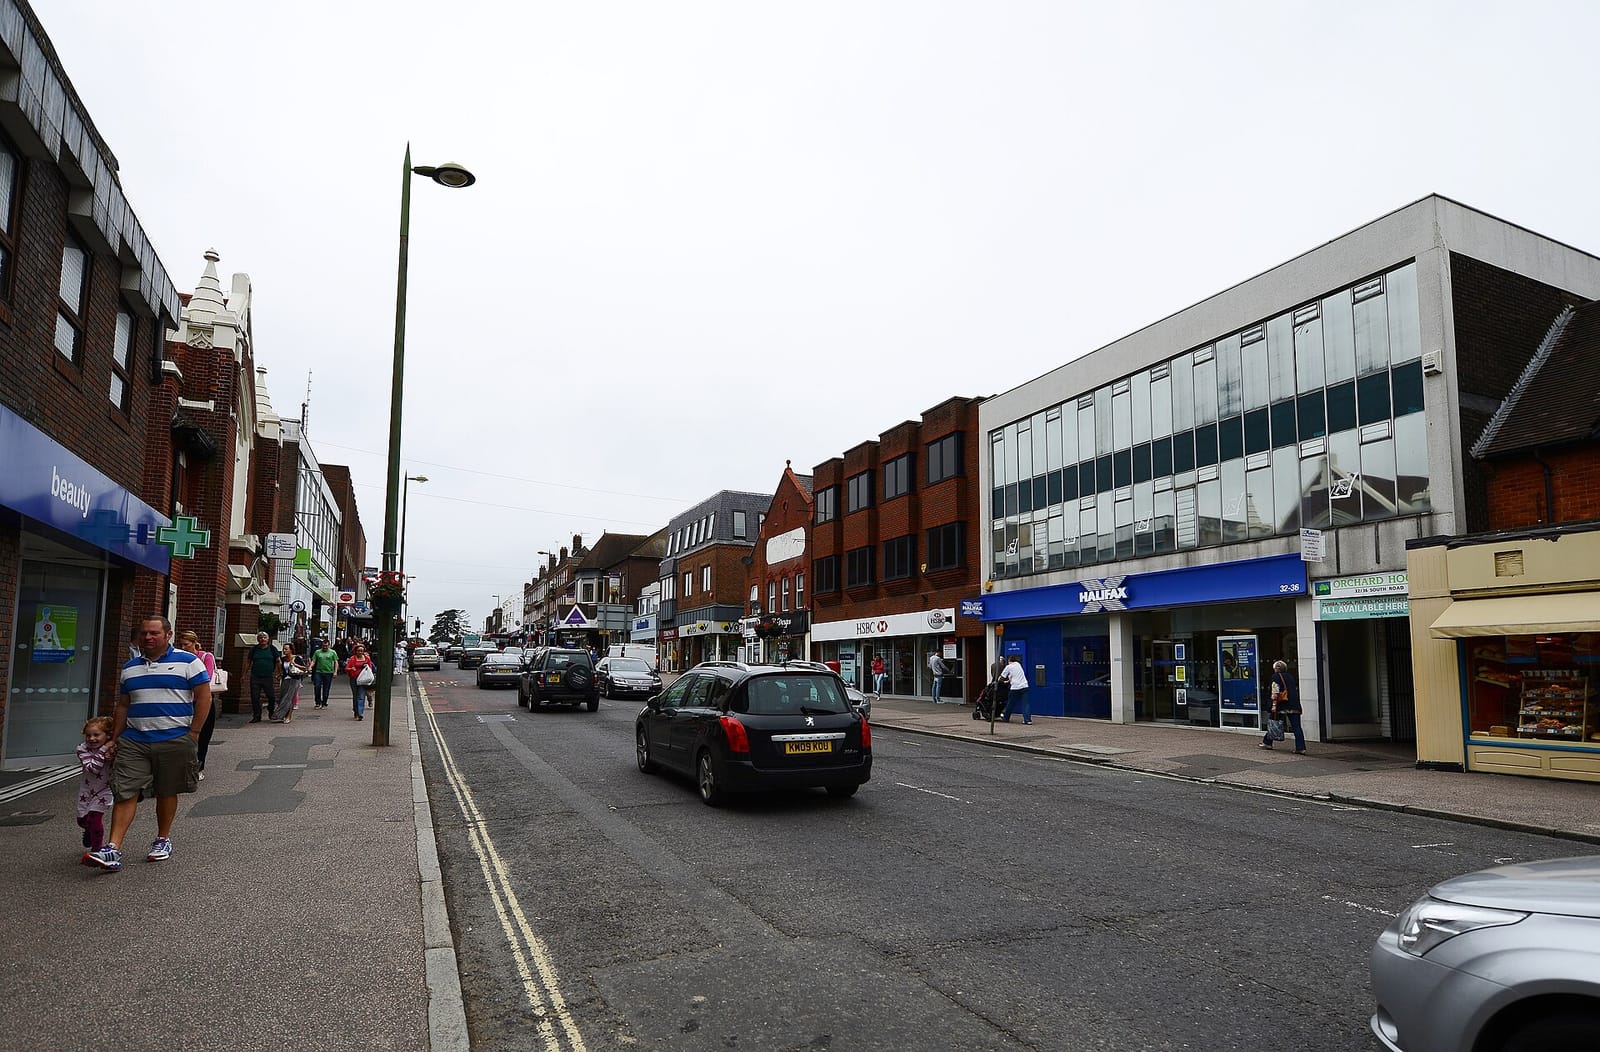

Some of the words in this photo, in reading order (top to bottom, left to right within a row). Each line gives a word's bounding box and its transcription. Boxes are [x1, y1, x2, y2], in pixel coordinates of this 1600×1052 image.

[51, 466, 91, 518] beauty
[1279, 582, 1300, 593] 32-36
[1333, 576, 1384, 588] ORCHARD
[1079, 587, 1128, 603] HALIFAX
[1322, 607, 1338, 615] ALL
[1338, 603, 1383, 613] AVAILABLE
[1385, 601, 1408, 611] HERE
[856, 621, 876, 635] HSBC
[930, 617, 946, 625] HSBC
